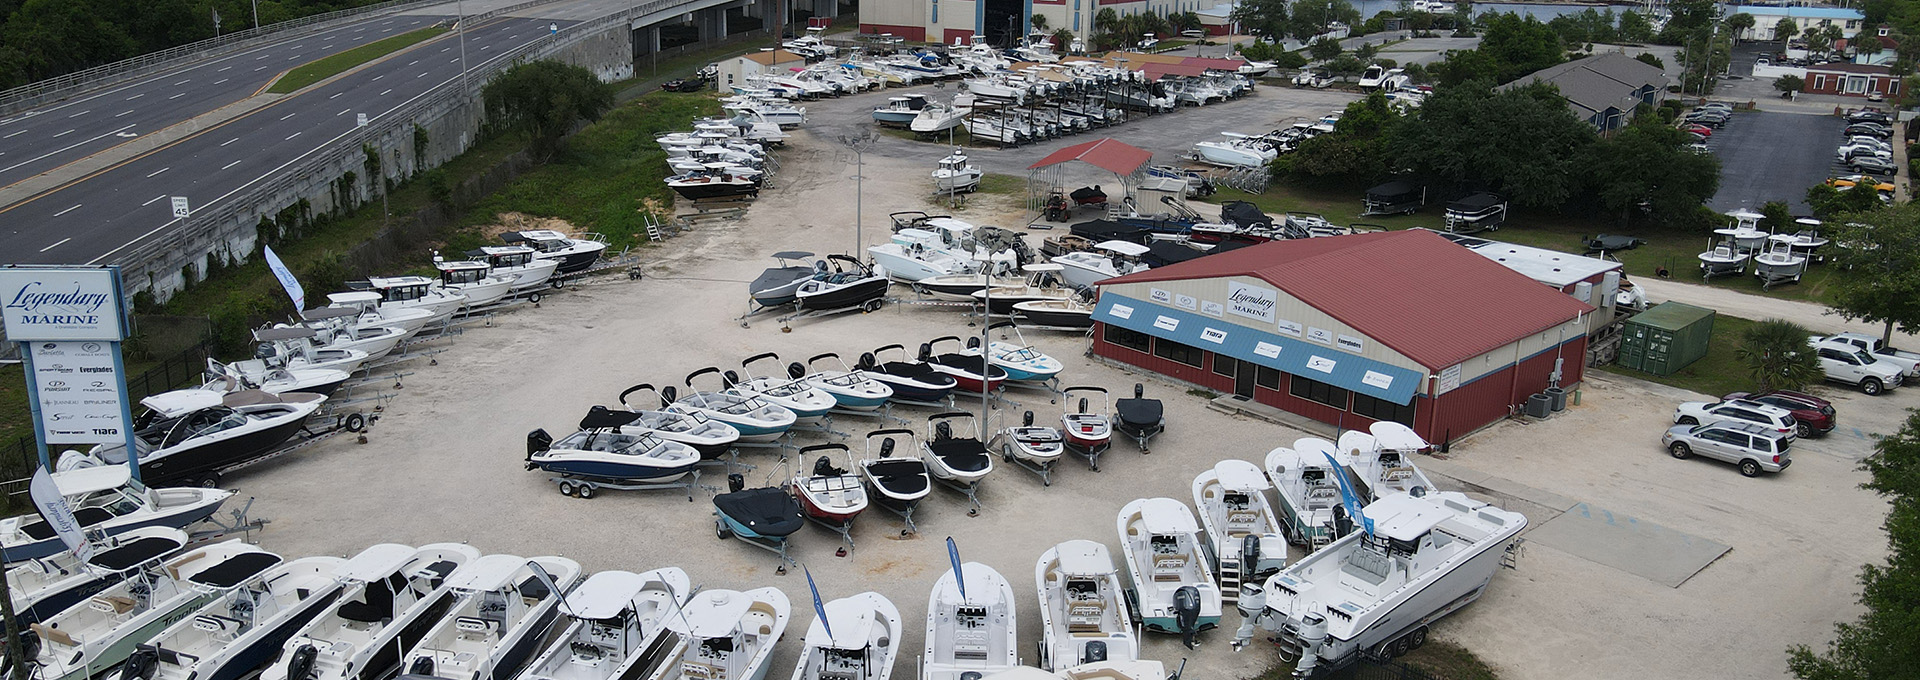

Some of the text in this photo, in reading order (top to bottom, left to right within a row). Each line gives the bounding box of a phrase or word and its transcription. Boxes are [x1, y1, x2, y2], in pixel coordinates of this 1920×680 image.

[6, 281, 108, 314] Legendary
[1228, 288, 1274, 311] Legendary
[21, 315, 99, 324] MARINE
[1233, 304, 1268, 318] MARINE
[1338, 338, 1362, 348] Everglades
[162, 602, 204, 627] Trophy
